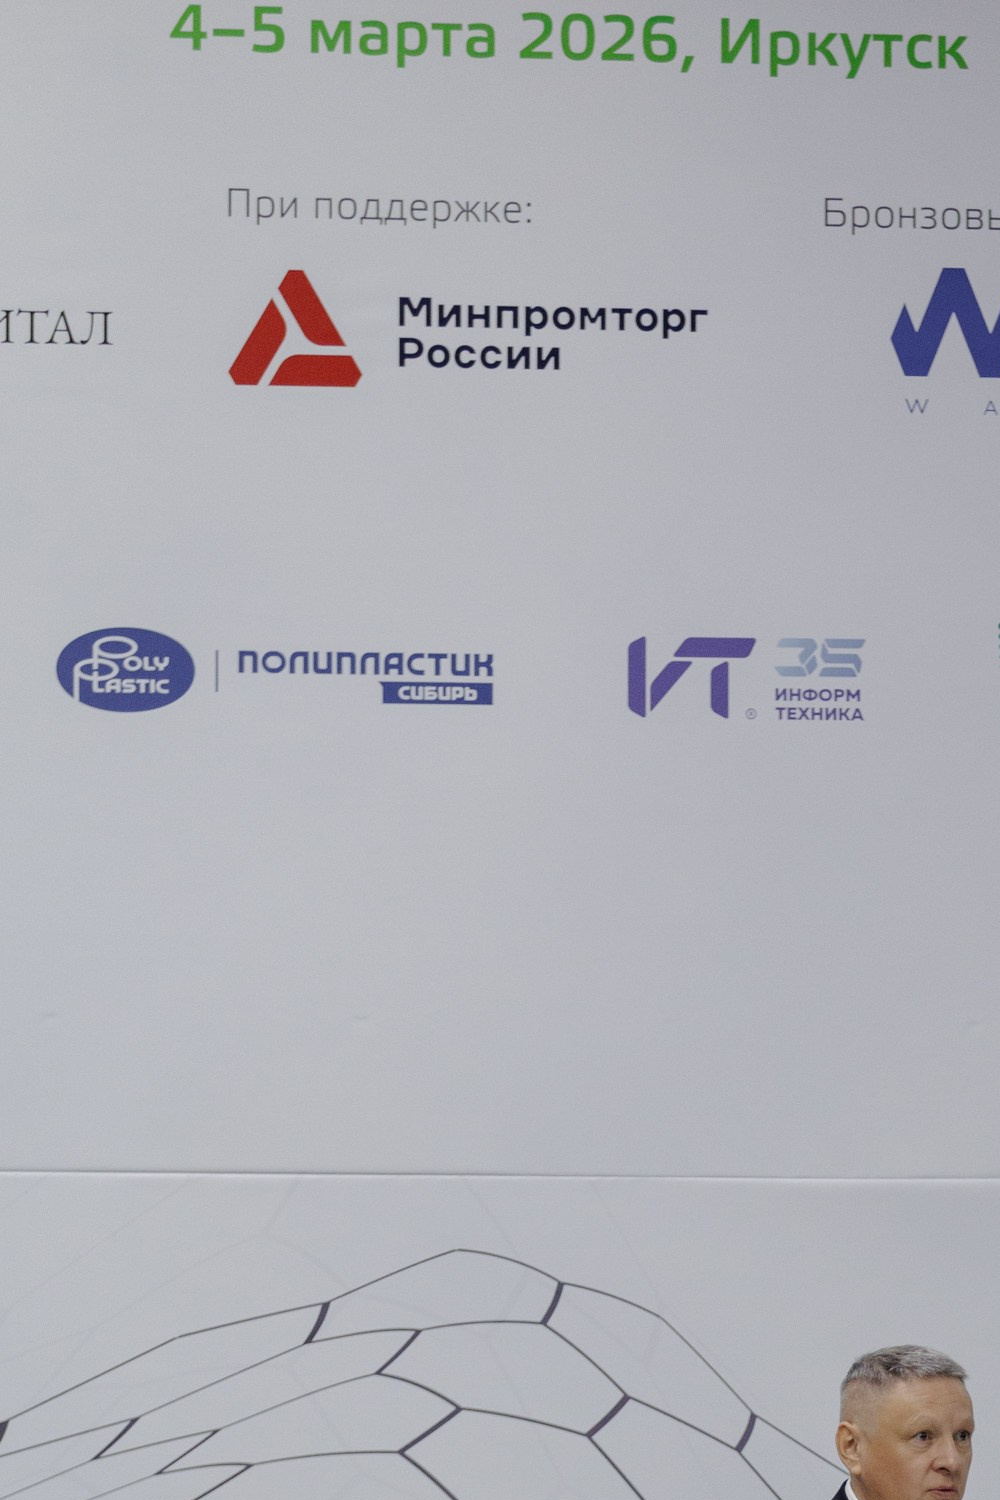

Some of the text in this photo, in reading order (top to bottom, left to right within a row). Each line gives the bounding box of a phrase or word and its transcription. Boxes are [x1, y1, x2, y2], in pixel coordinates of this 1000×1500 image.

[170, 4, 968, 79] 4–5 марта 2026, Иркутск
[227, 187, 532, 229] При поддержке:
[398, 296, 708, 336] Минпромторг
[398, 337, 561, 370] России
[237, 650, 494, 677] ПОЛИПЛАСТИК
[398, 686, 478, 702] СИБИРЬ
[775, 688, 861, 702] ИНФОРМ
[775, 706, 865, 721] ТЕХНИКА
